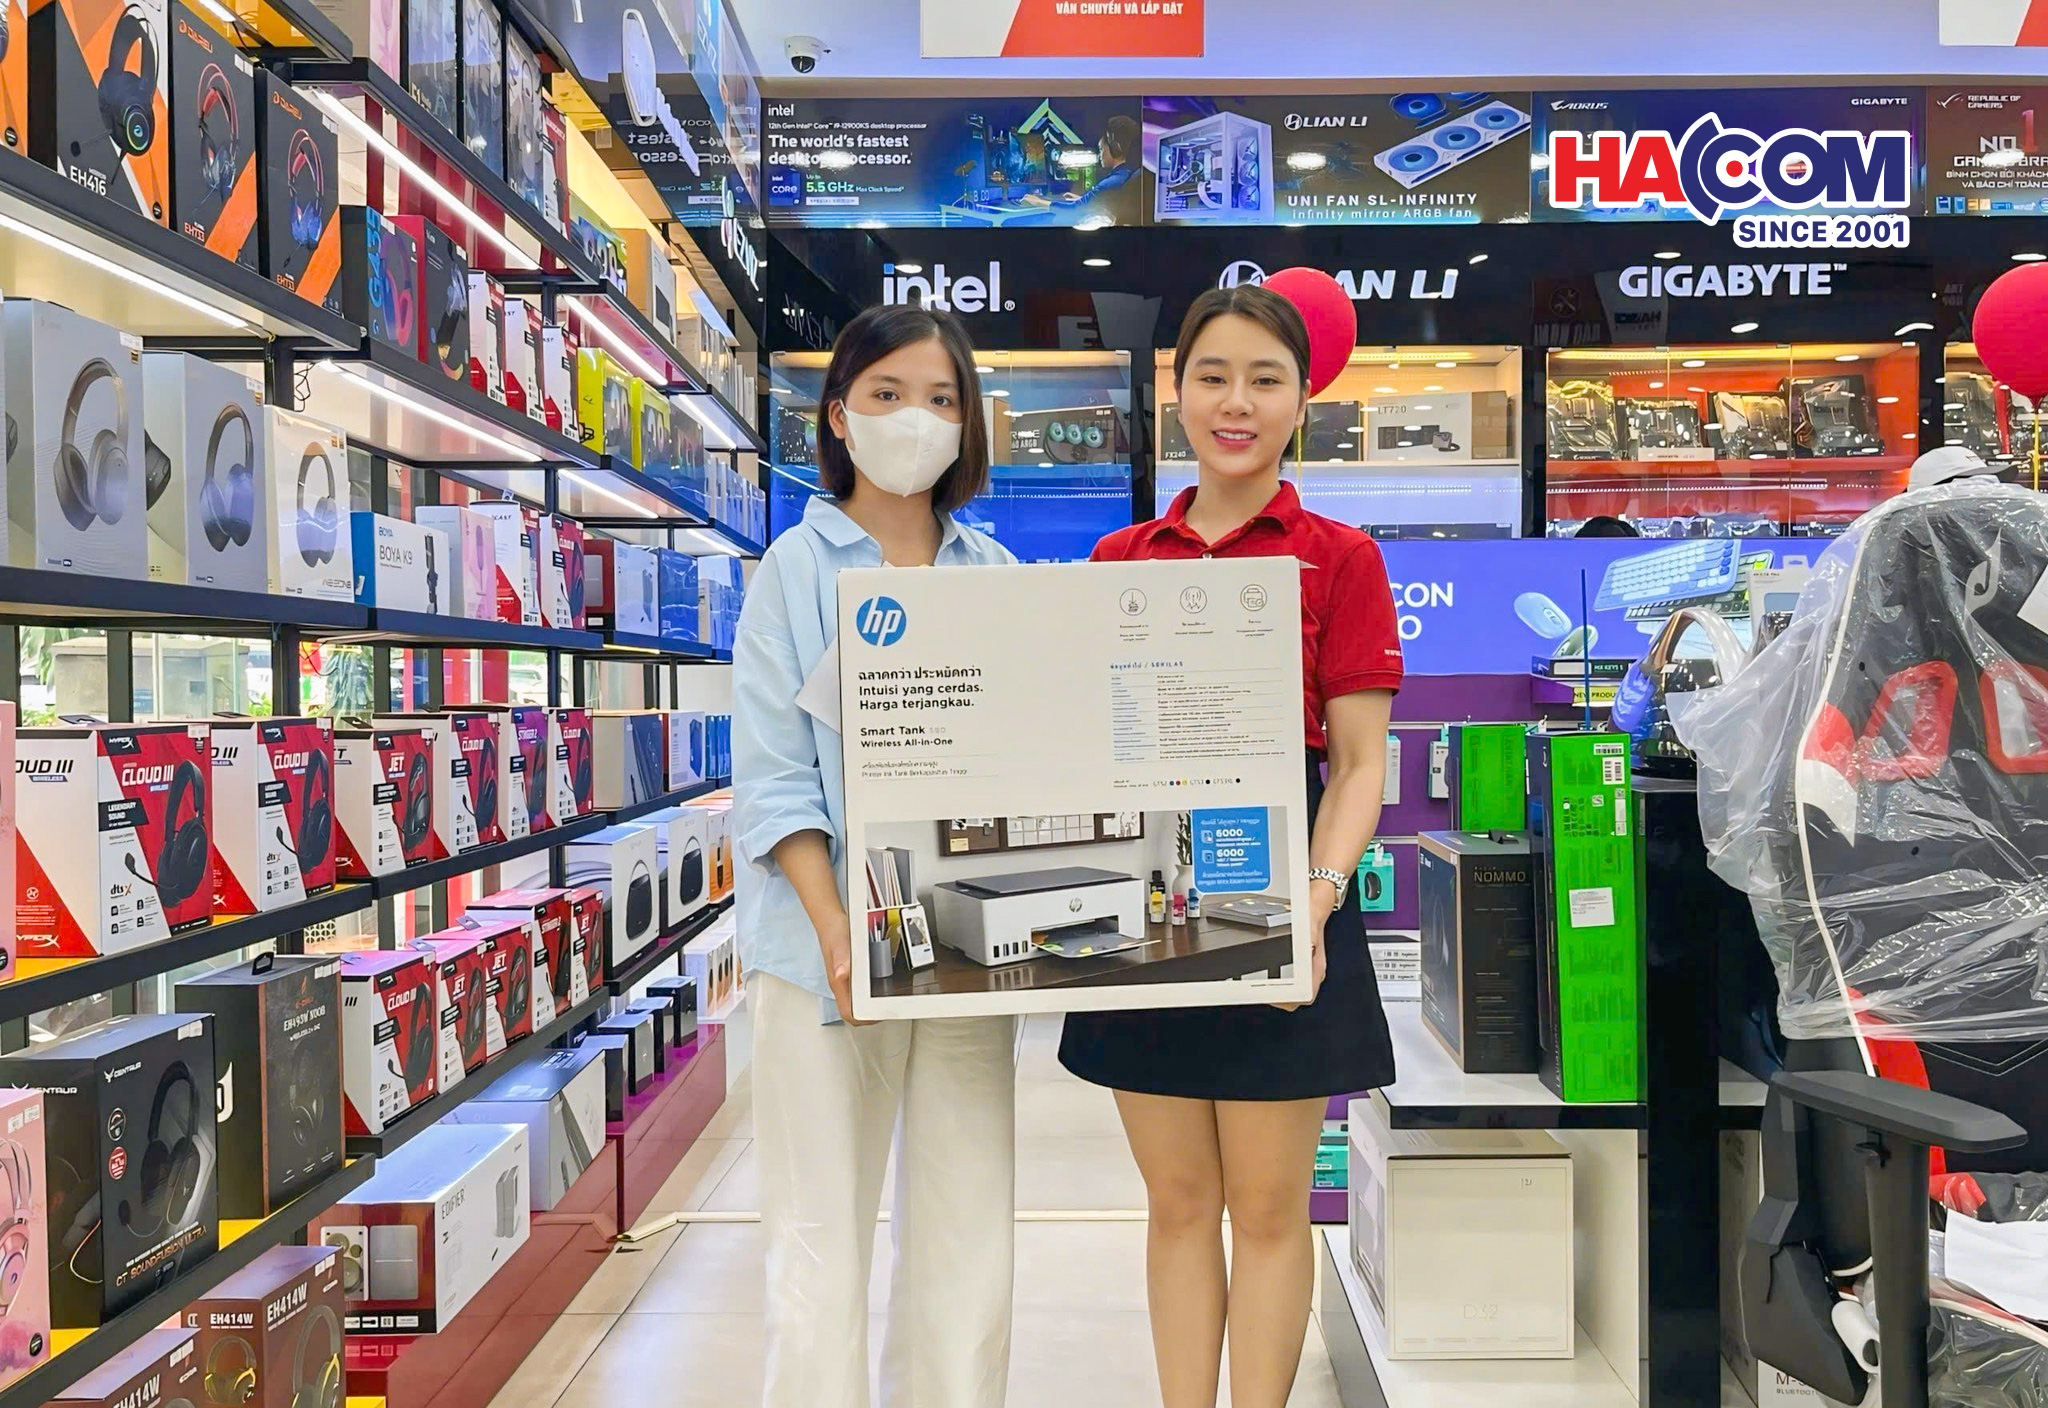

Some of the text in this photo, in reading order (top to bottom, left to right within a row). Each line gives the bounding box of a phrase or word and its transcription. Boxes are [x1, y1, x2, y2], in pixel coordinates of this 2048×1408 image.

[1850, 98, 1909, 106] GIGABYTE
[768, 104, 794, 117] intel
[870, 122, 895, 131] desktop
[896, 122, 928, 131] processor
[1303, 116, 1368, 128] LIAN LI
[768, 135, 798, 148] The
[857, 134, 909, 148] fastest
[768, 152, 832, 167] deskto
[70, 165, 107, 196] EH416
[806, 181, 826, 193] 5.5
[828, 181, 854, 193] GHz
[1288, 193, 1477, 207] UNI FAN SL-INFINITY
[1293, 207, 1473, 221] infinity mirror ARGB fan
[1410, 268, 1459, 300] LI
[380, 545, 413, 565] BOYA K9
[861, 597, 902, 647] hp
[859, 682, 984, 697] Intuisi yang cerdas.
[860, 698, 975, 712] Harga terjangkau.
[860, 727, 895, 737] Smart
[898, 726, 926, 735] Tank
[861, 737, 954, 749] Wireless All-in-One
[274, 754, 301, 770] CLOUD
[389, 757, 404, 772] JET
[121, 764, 175, 787] CLOUD III
[1215, 829, 1244, 838] 6000
[1216, 848, 1245, 858] 6000
[1474, 871, 1526, 883] NOMMO
[267, 1283, 308, 1323] EH414W
[210, 1313, 254, 1325] EH414W
[1776, 1388, 1819, 1396] BLUETOOT
